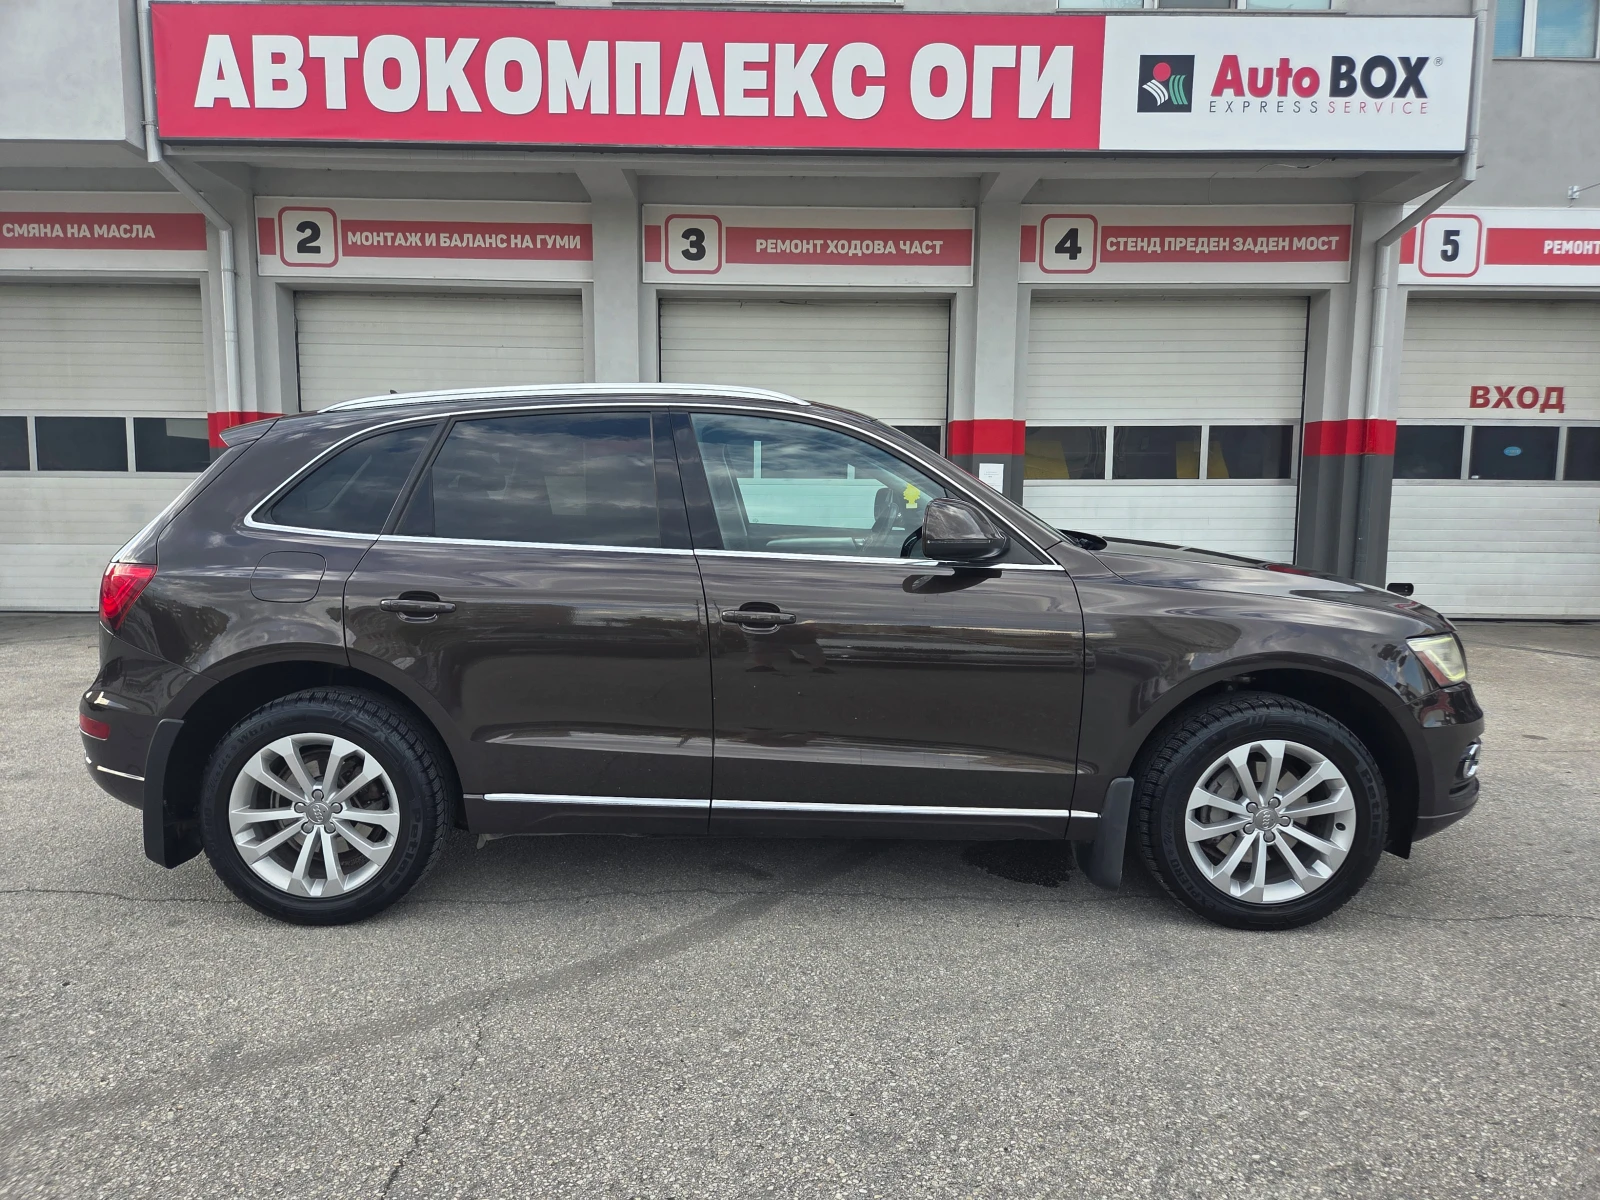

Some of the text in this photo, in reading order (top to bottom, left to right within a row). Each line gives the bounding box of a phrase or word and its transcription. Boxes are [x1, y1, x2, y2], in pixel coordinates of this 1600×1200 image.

[194, 34, 1074, 120] АВТОКОМПЛЕКС ОГИ
[1210, 54, 1430, 99] Auto BOX
[2, 223, 156, 239] СМЯНА НА МАСЛА
[295, 220, 322, 254] 2
[346, 231, 581, 250] МОНТАЖ И БАЛАНС НА ГУМИ
[681, 227, 707, 261] 3
[1054, 227, 1082, 261] 4
[1105, 236, 1339, 254] СТЕНД ПРЕДЕН ЗАДЕН МОСТ
[1440, 229, 1461, 262] 5
[755, 238, 944, 257] РЕМОНТ ХОДОВА ЧАСТ
[1543, 240, 1600, 255] РЕМОНТ
[1469, 385, 1567, 414] ВХОД
